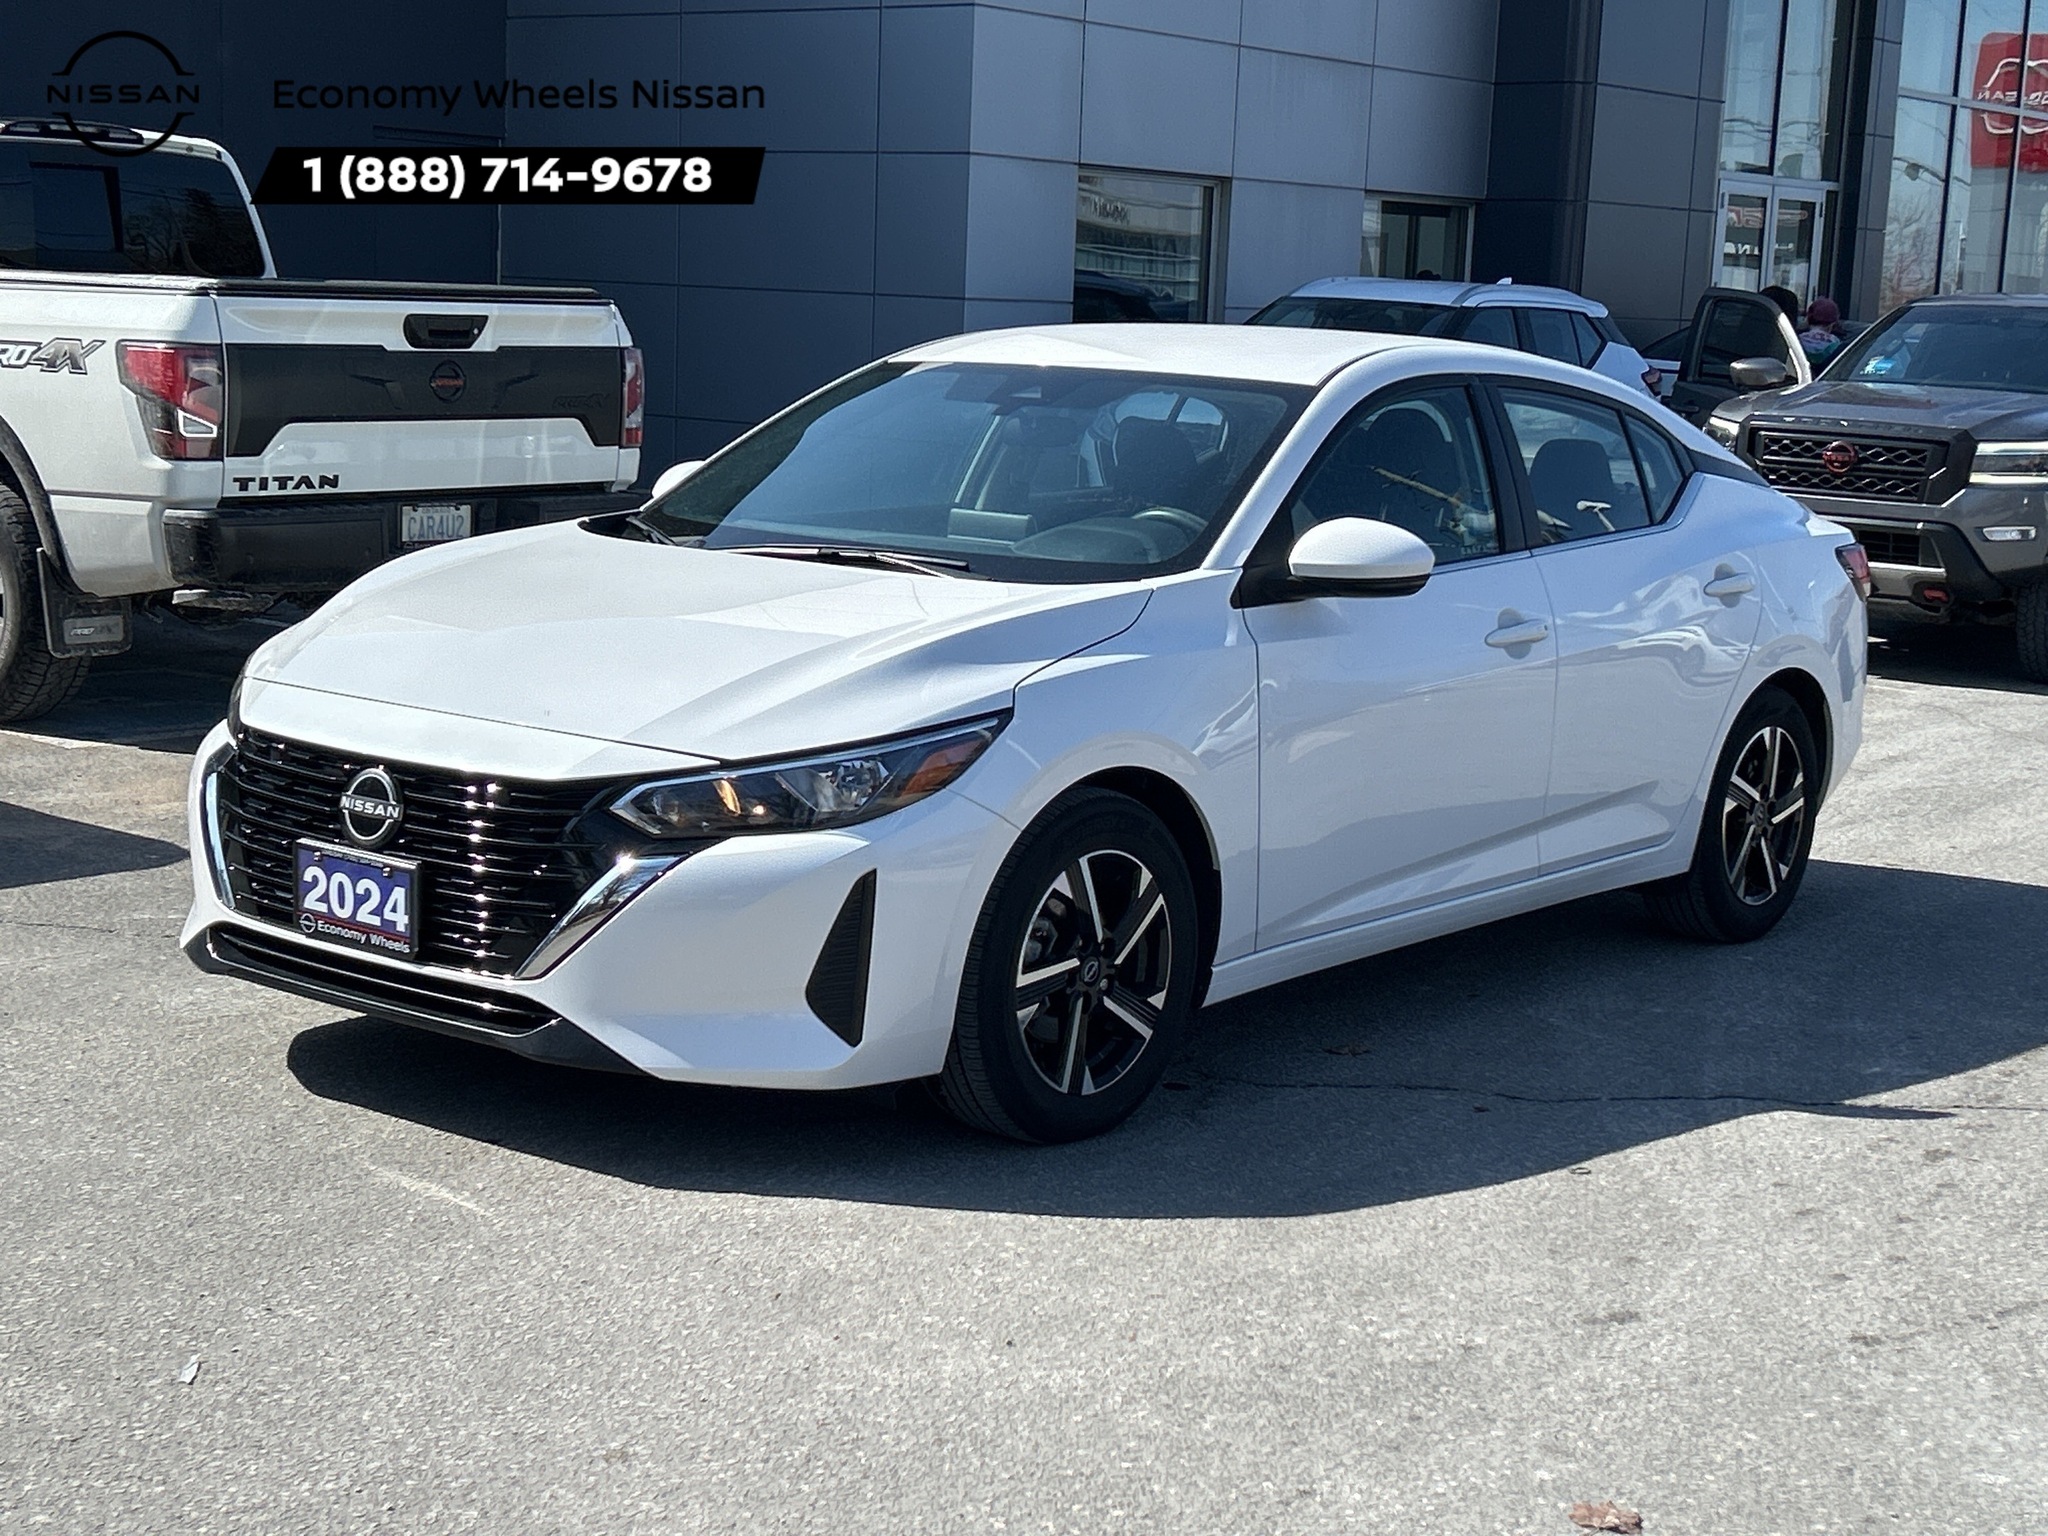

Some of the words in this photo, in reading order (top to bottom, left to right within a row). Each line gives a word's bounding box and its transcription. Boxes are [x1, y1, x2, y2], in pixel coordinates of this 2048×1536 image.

[232, 474, 340, 492] TITAN
[407, 514, 465, 541] CAR4U2
[340, 795, 400, 818] NISSAN
[302, 865, 410, 933] 2024
[316, 920, 368, 944] Economy
[369, 933, 411, 953] Wheels
